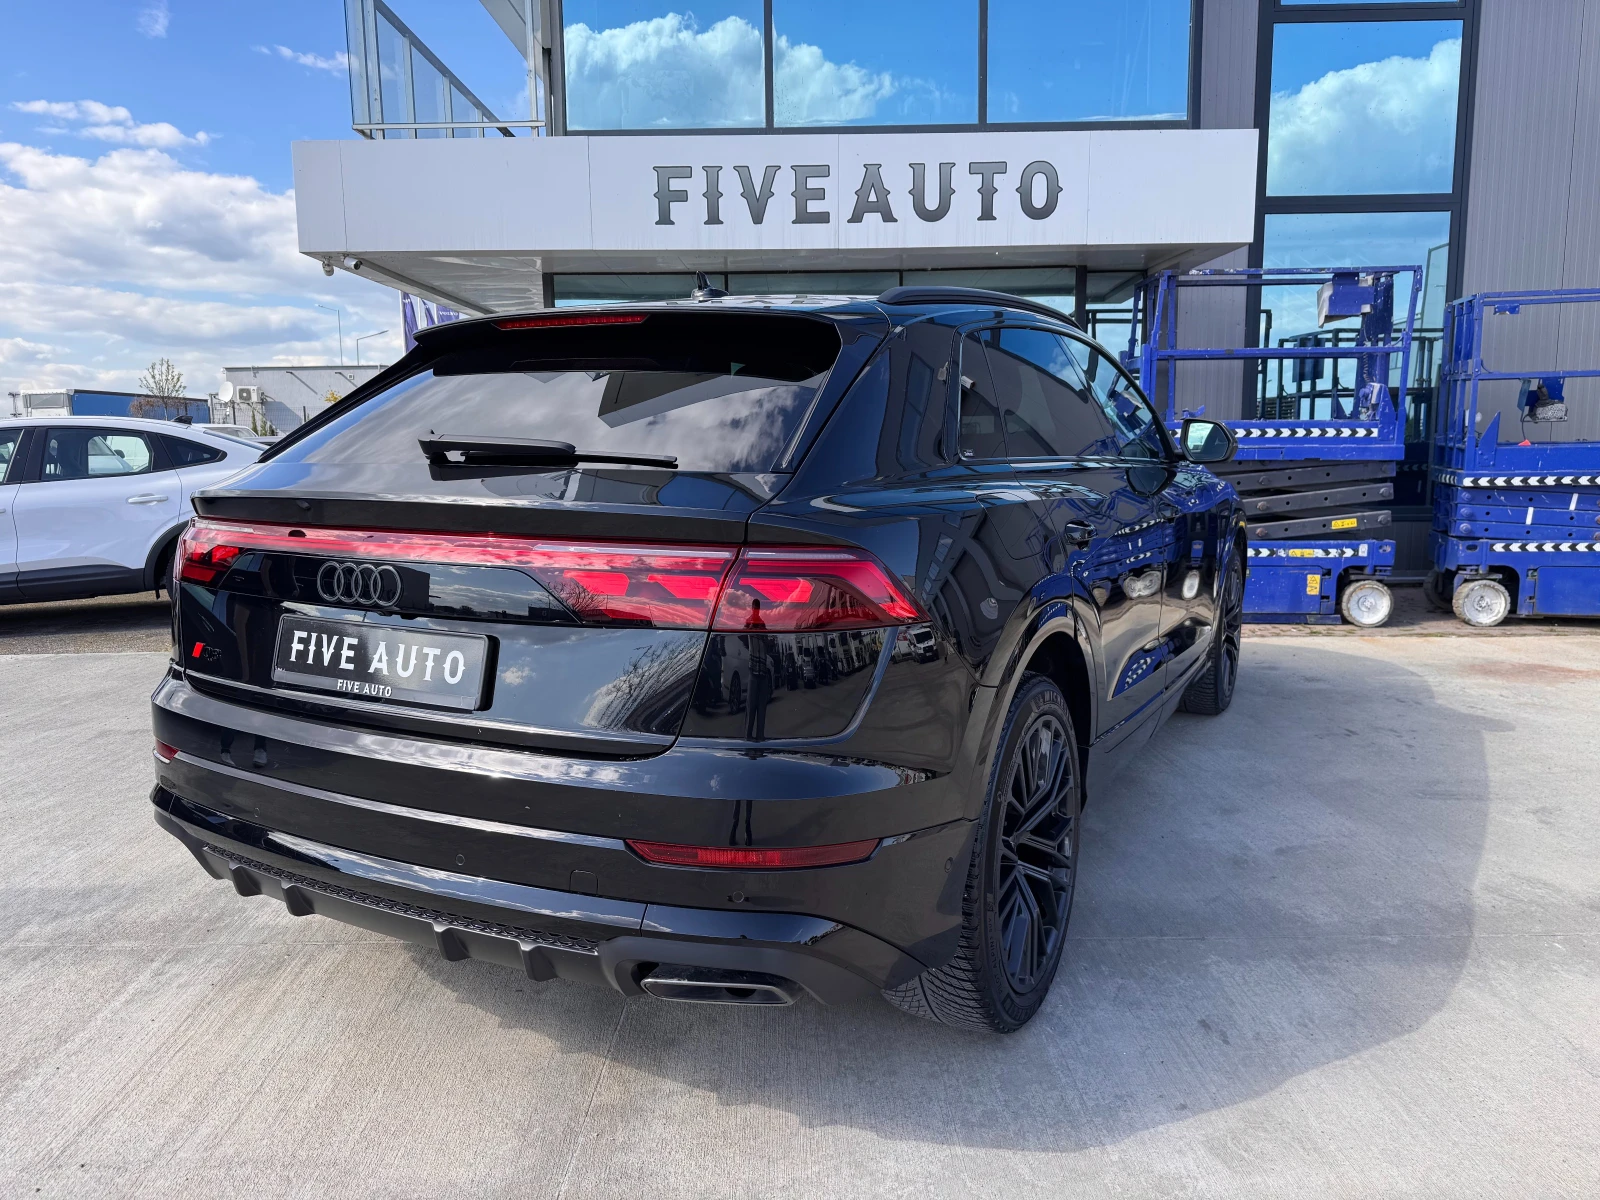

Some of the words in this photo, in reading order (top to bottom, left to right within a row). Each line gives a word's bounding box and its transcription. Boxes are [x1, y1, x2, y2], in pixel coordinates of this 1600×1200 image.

[289, 629, 359, 670] FIVE
[368, 641, 466, 685] AUTO
[336, 679, 360, 693] FIVE
[362, 683, 392, 698] AUTO
